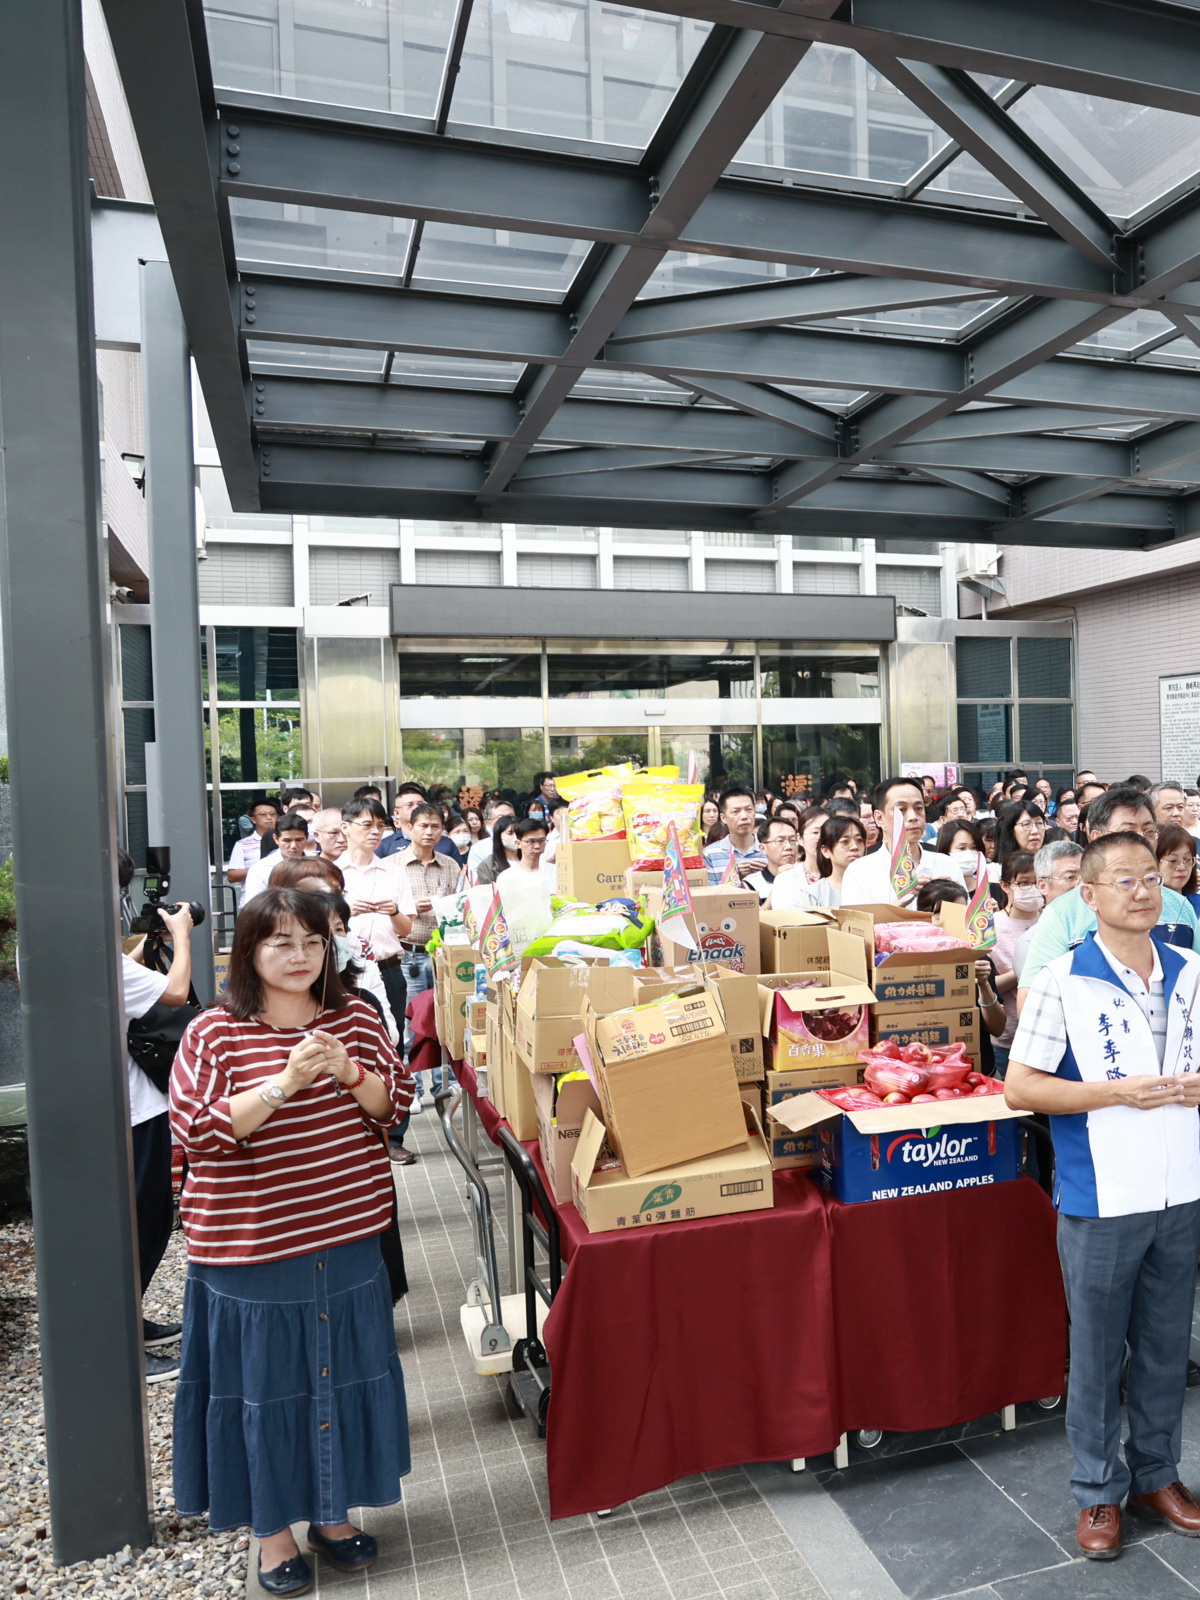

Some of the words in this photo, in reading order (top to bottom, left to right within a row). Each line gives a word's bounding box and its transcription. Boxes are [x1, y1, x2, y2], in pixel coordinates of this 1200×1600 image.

[596, 872, 627, 884] Carr
[787, 1043, 826, 1058] 百香果
[558, 1128, 582, 1140] Nes
[902, 1133, 972, 1168] taylor
[933, 1158, 948, 1167] NEW
[949, 1155, 979, 1165] ZEALAND
[872, 1188, 899, 1201] NEW
[901, 1180, 953, 1197] ZEALAND
[956, 1174, 995, 1188] APPLES
